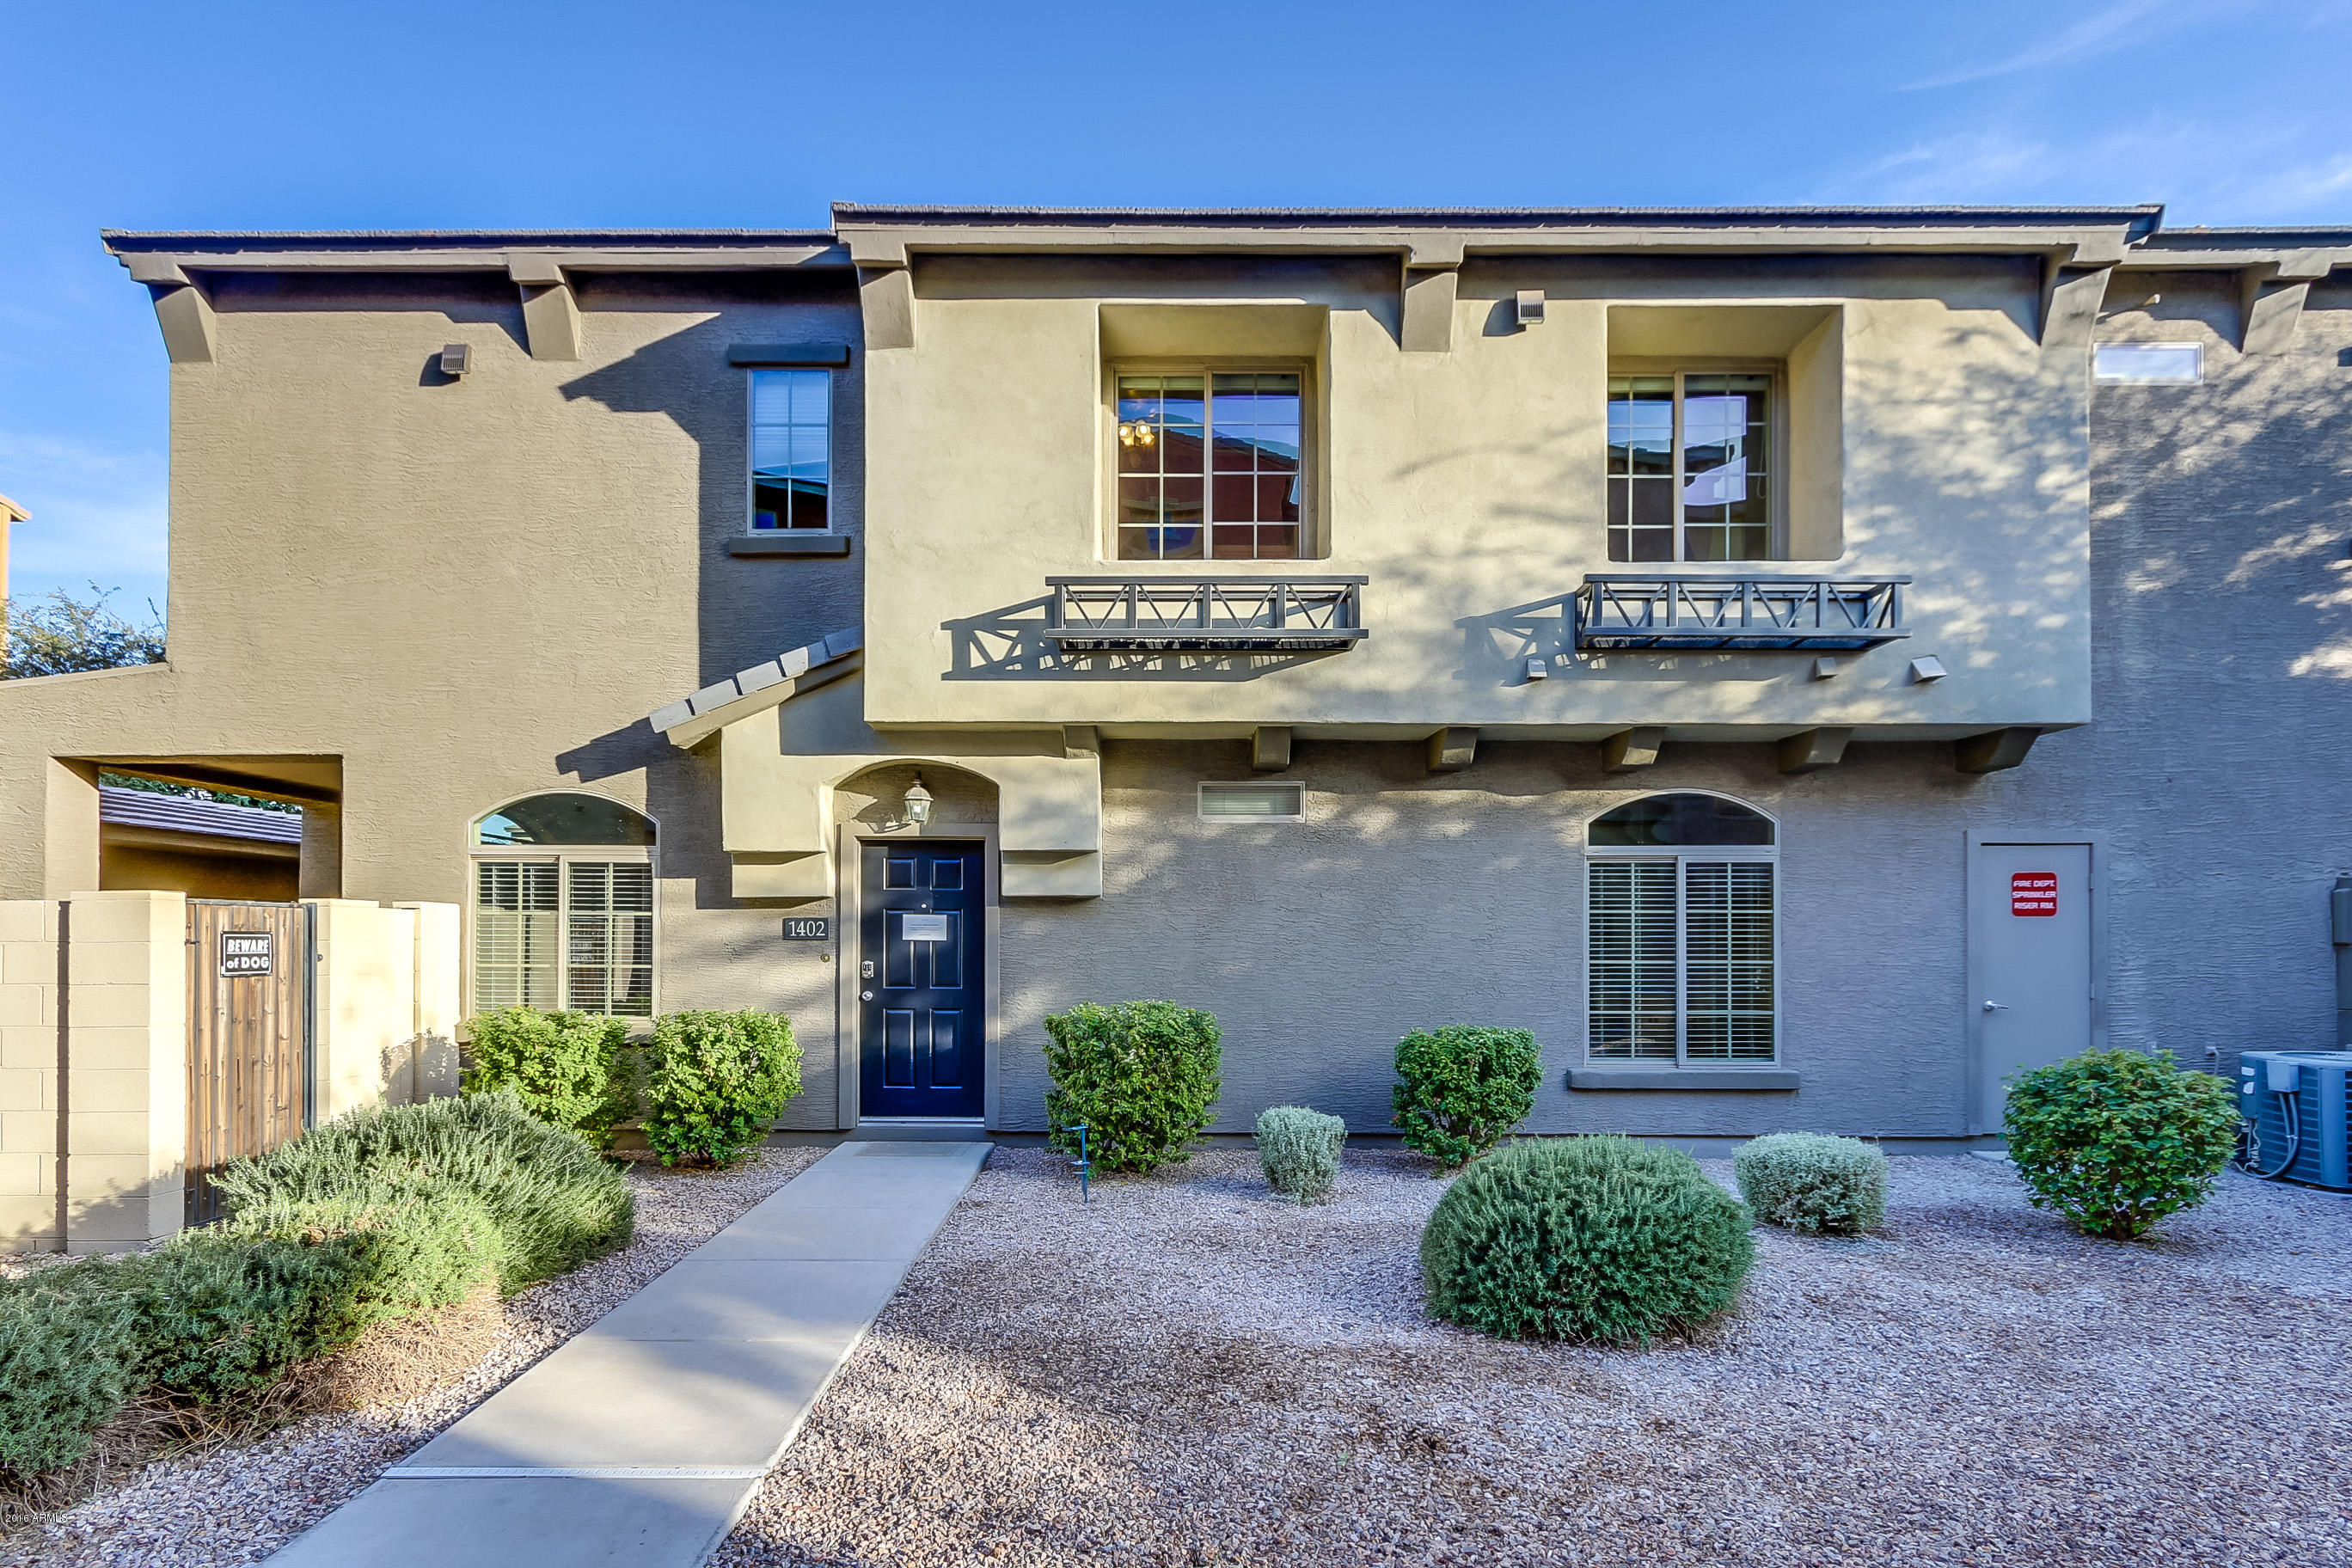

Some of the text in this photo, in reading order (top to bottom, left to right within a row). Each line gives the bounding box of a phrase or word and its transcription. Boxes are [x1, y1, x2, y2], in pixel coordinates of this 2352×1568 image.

[788, 920, 826, 937] 1402
[227, 939, 269, 952] BEWARE
[226, 956, 269, 969] of DOG
